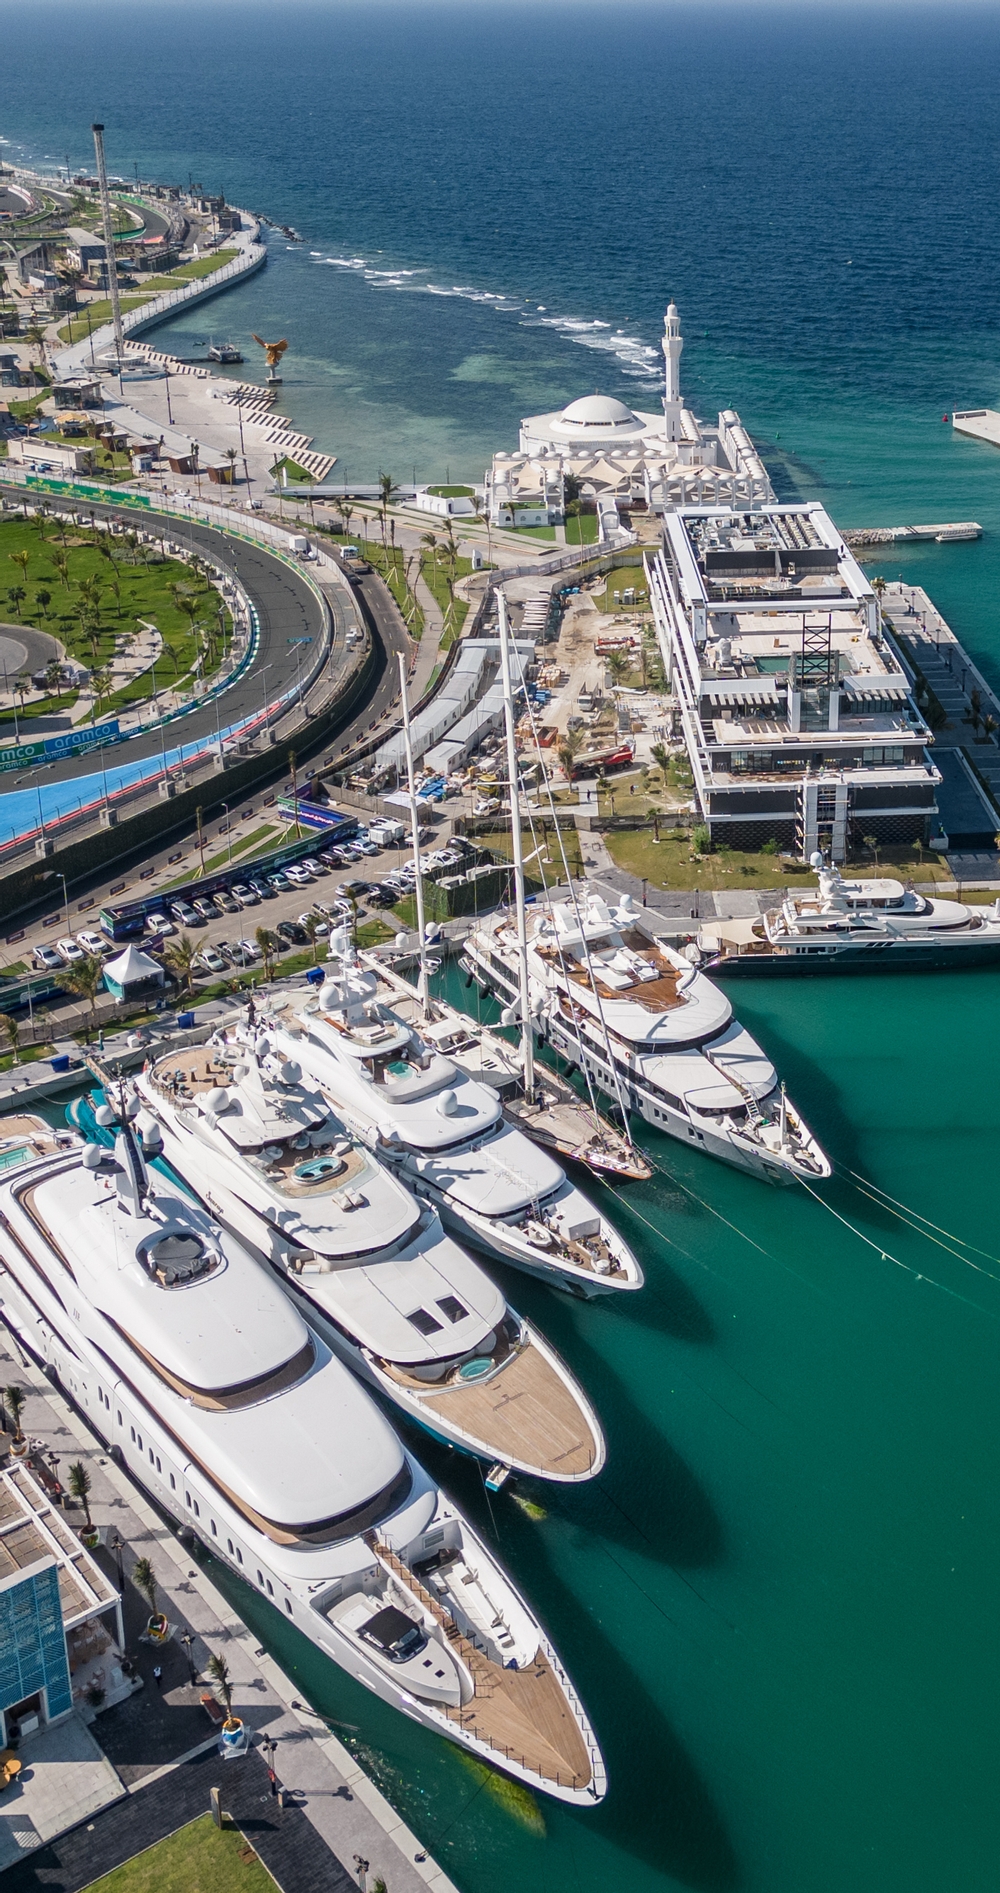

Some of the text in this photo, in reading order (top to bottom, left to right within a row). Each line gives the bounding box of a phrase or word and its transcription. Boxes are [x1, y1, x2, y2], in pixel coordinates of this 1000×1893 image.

[55, 725, 110, 748] aramco
[78, 739, 105, 752] aramo
[1, 746, 35, 761] mco
[38, 750, 68, 762] aramco
